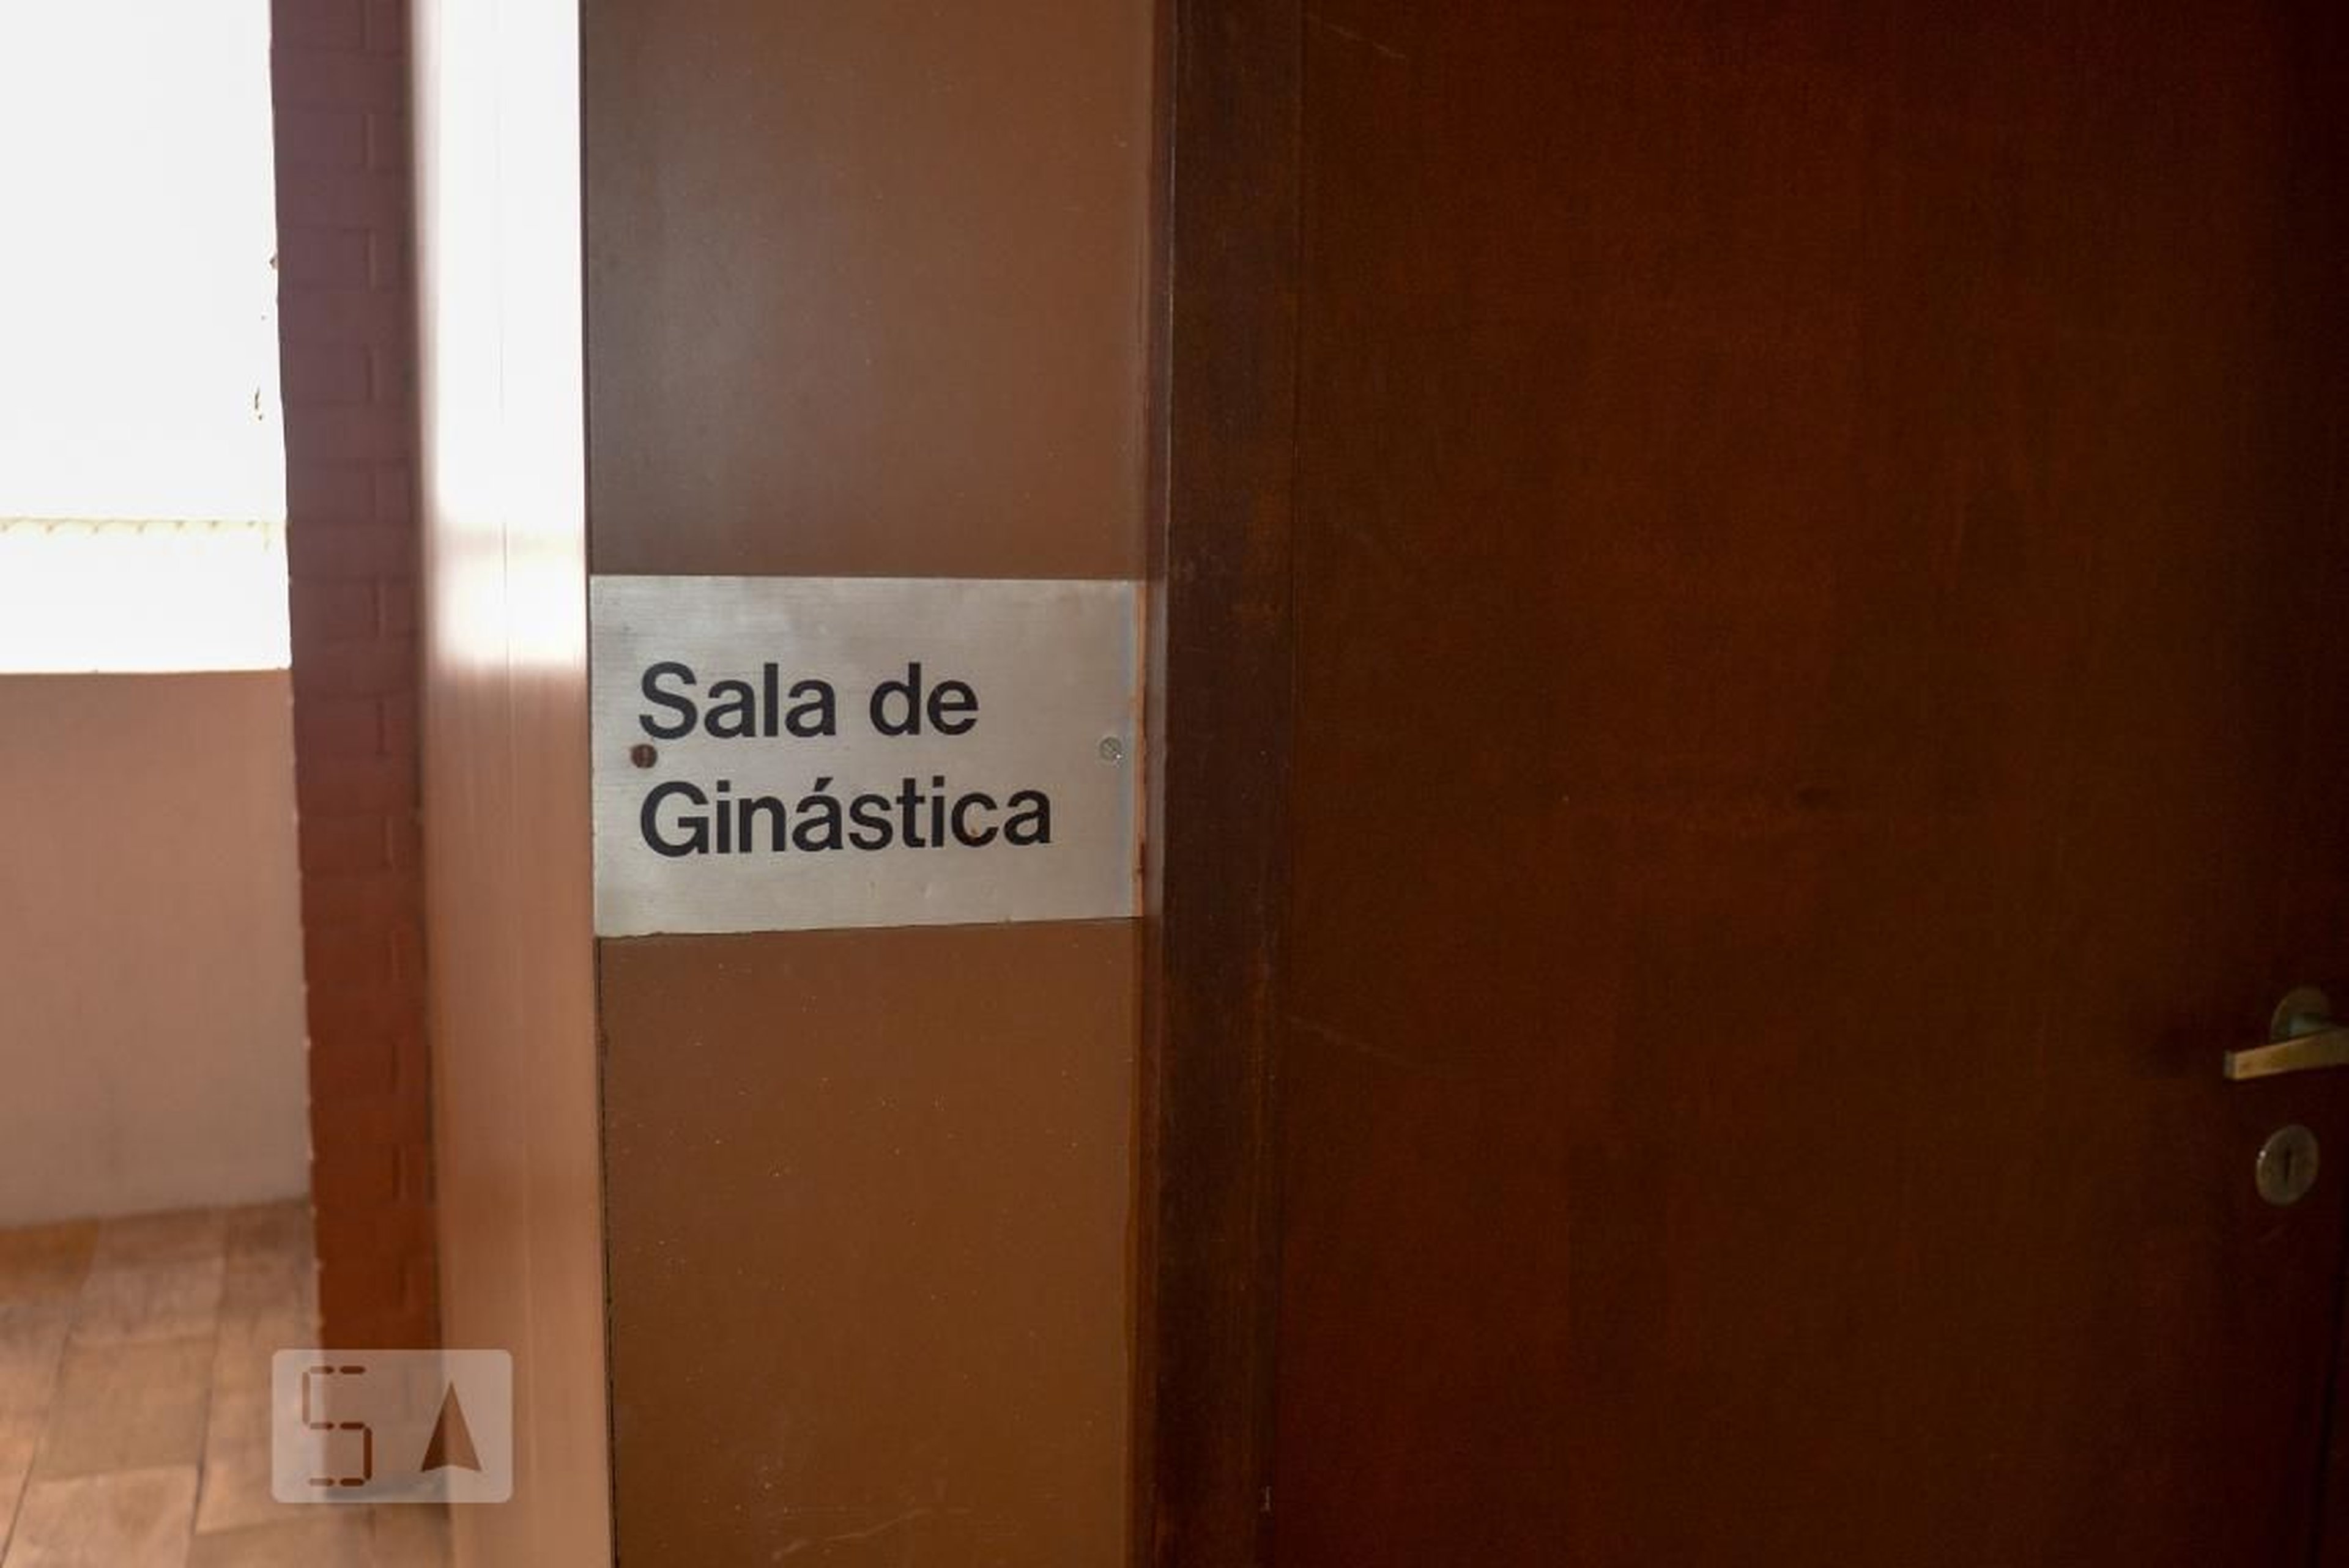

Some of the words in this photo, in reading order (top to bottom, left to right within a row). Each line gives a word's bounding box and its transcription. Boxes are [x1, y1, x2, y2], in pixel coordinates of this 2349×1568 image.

[639, 661, 836, 740] Sala
[869, 661, 980, 737] de
[640, 775, 1053, 858] Ginástica
